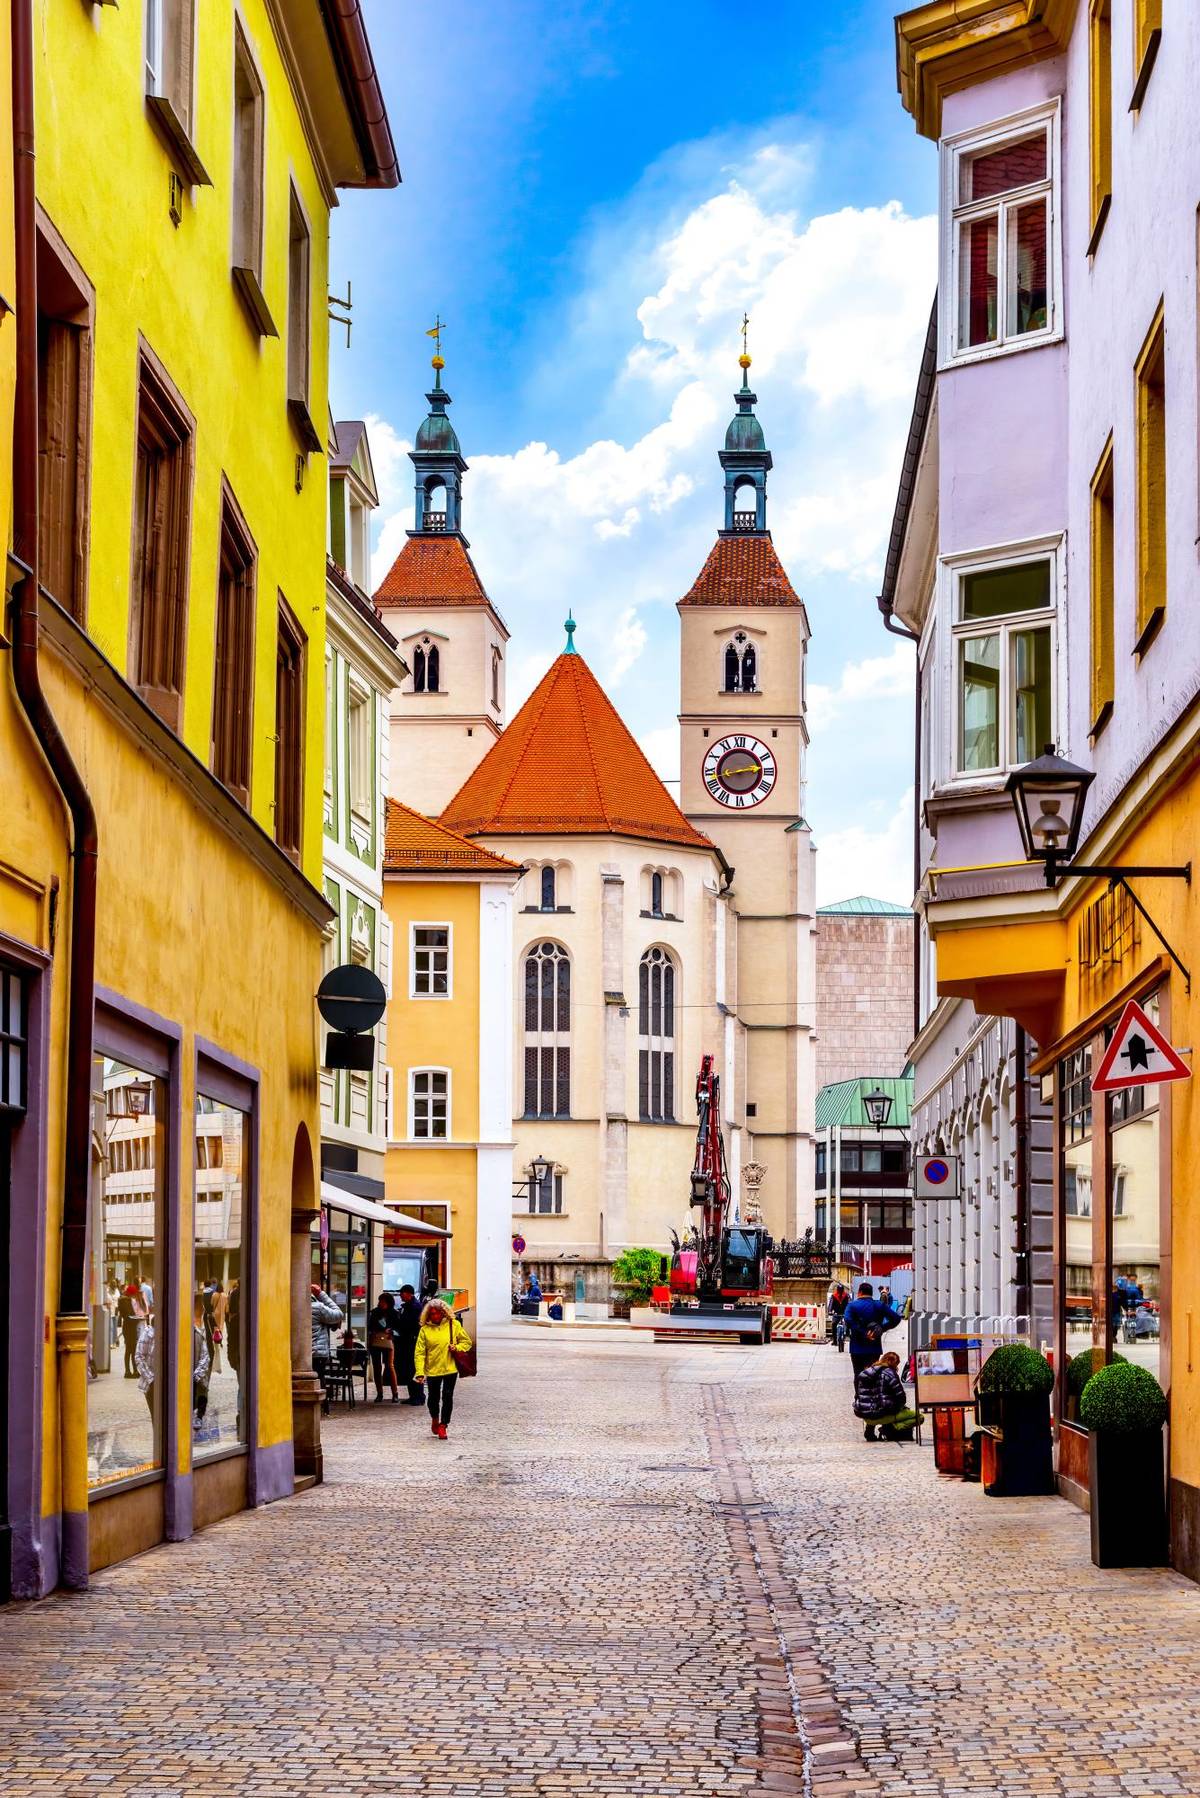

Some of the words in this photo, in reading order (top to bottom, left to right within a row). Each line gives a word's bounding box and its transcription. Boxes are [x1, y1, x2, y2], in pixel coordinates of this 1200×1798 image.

[719, 739, 732, 752] XI
[733, 737, 746, 748] XII
[751, 741, 758, 751] I
[708, 752, 720, 762] X
[759, 752, 771, 762] II
[763, 767, 774, 776] III
[735, 796, 745, 806] VI
